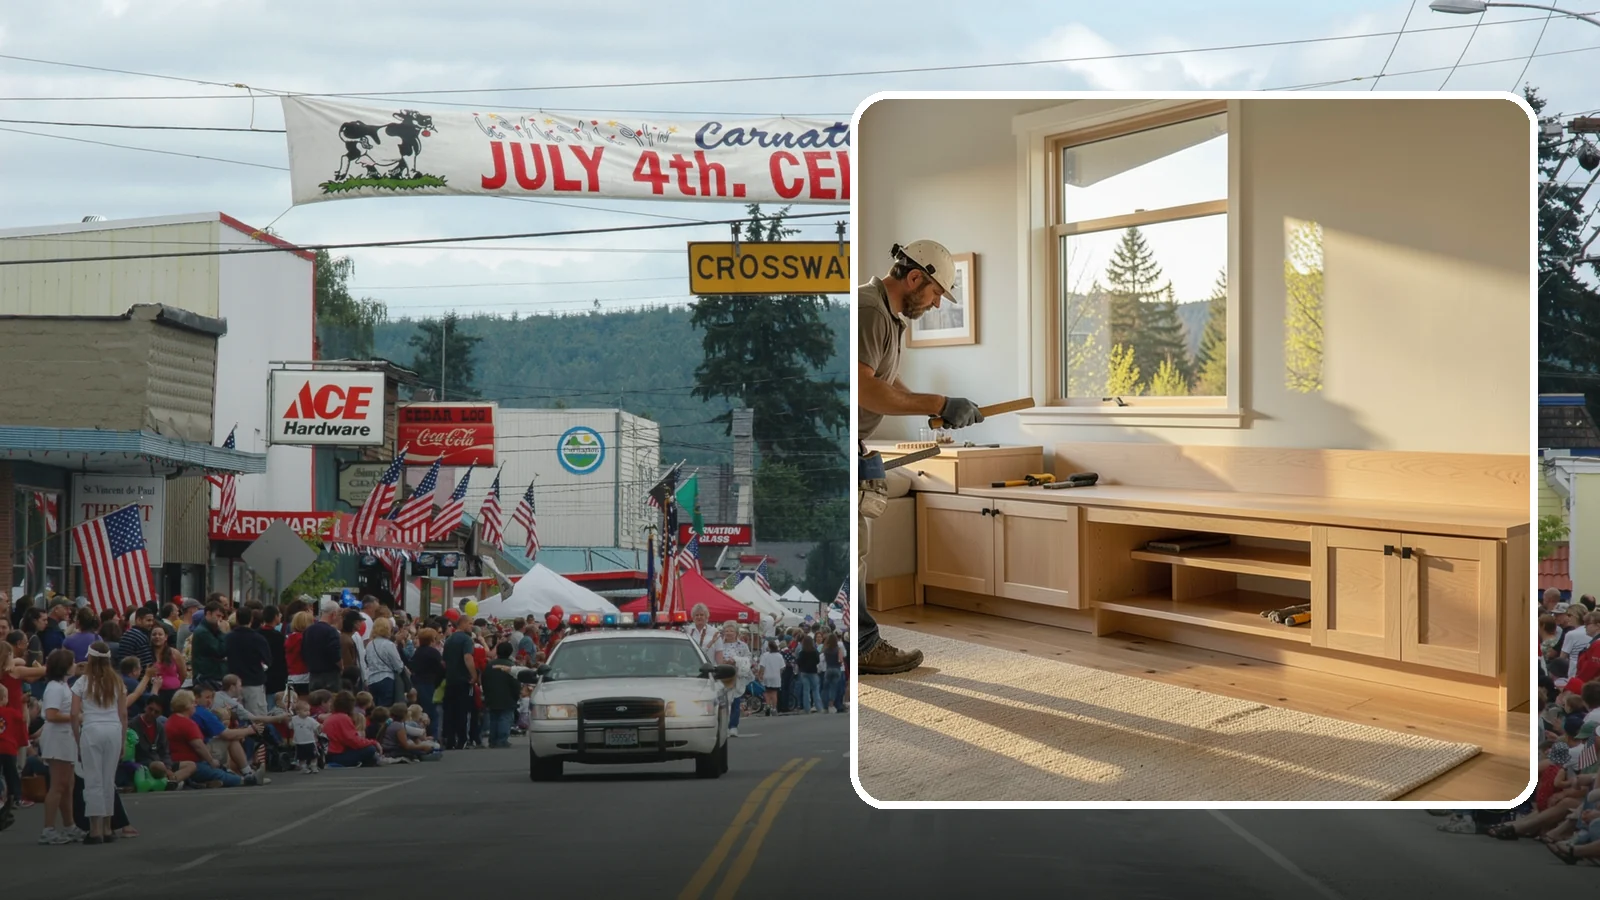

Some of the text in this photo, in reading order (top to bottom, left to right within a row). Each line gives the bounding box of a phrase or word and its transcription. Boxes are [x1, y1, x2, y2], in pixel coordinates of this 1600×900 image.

[481, 140, 605, 192] JULY
[632, 150, 746, 197] 4th.
[697, 254, 850, 280] CROSSWA
[283, 380, 374, 420] ACE
[406, 409, 485, 422] CEDAR LOG
[283, 421, 371, 436] Hardware
[416, 428, 477, 447] Coca-Cola
[354, 467, 386, 480] Simpl
[83, 485, 155, 495] St. Vincent de Paul
[81, 502, 153, 522] THT
[212, 516, 331, 535] HARDARE
[688, 526, 742, 535] CRNATION
[699, 535, 730, 543] GLASS
